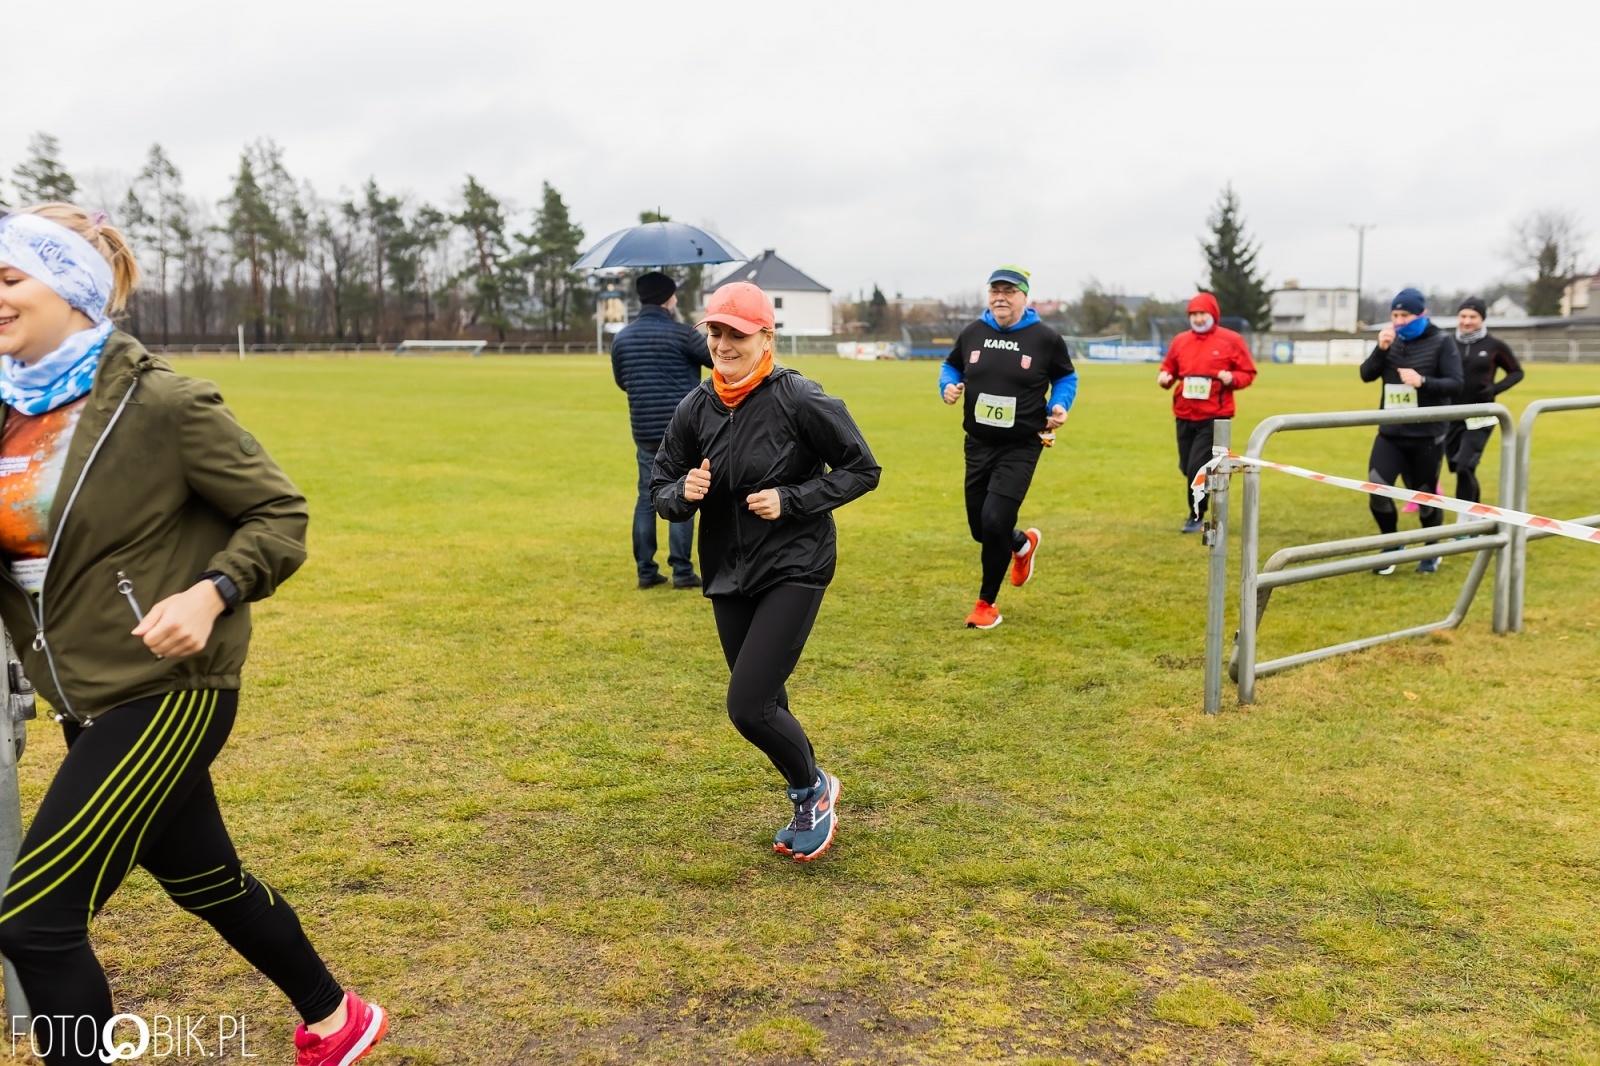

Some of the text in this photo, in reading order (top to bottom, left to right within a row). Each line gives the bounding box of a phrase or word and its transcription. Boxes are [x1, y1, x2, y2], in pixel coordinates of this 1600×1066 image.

[983, 338, 1020, 352] KAROL
[1189, 384, 1206, 394] 115
[1389, 393, 1411, 404] 114
[986, 404, 1004, 420] 76
